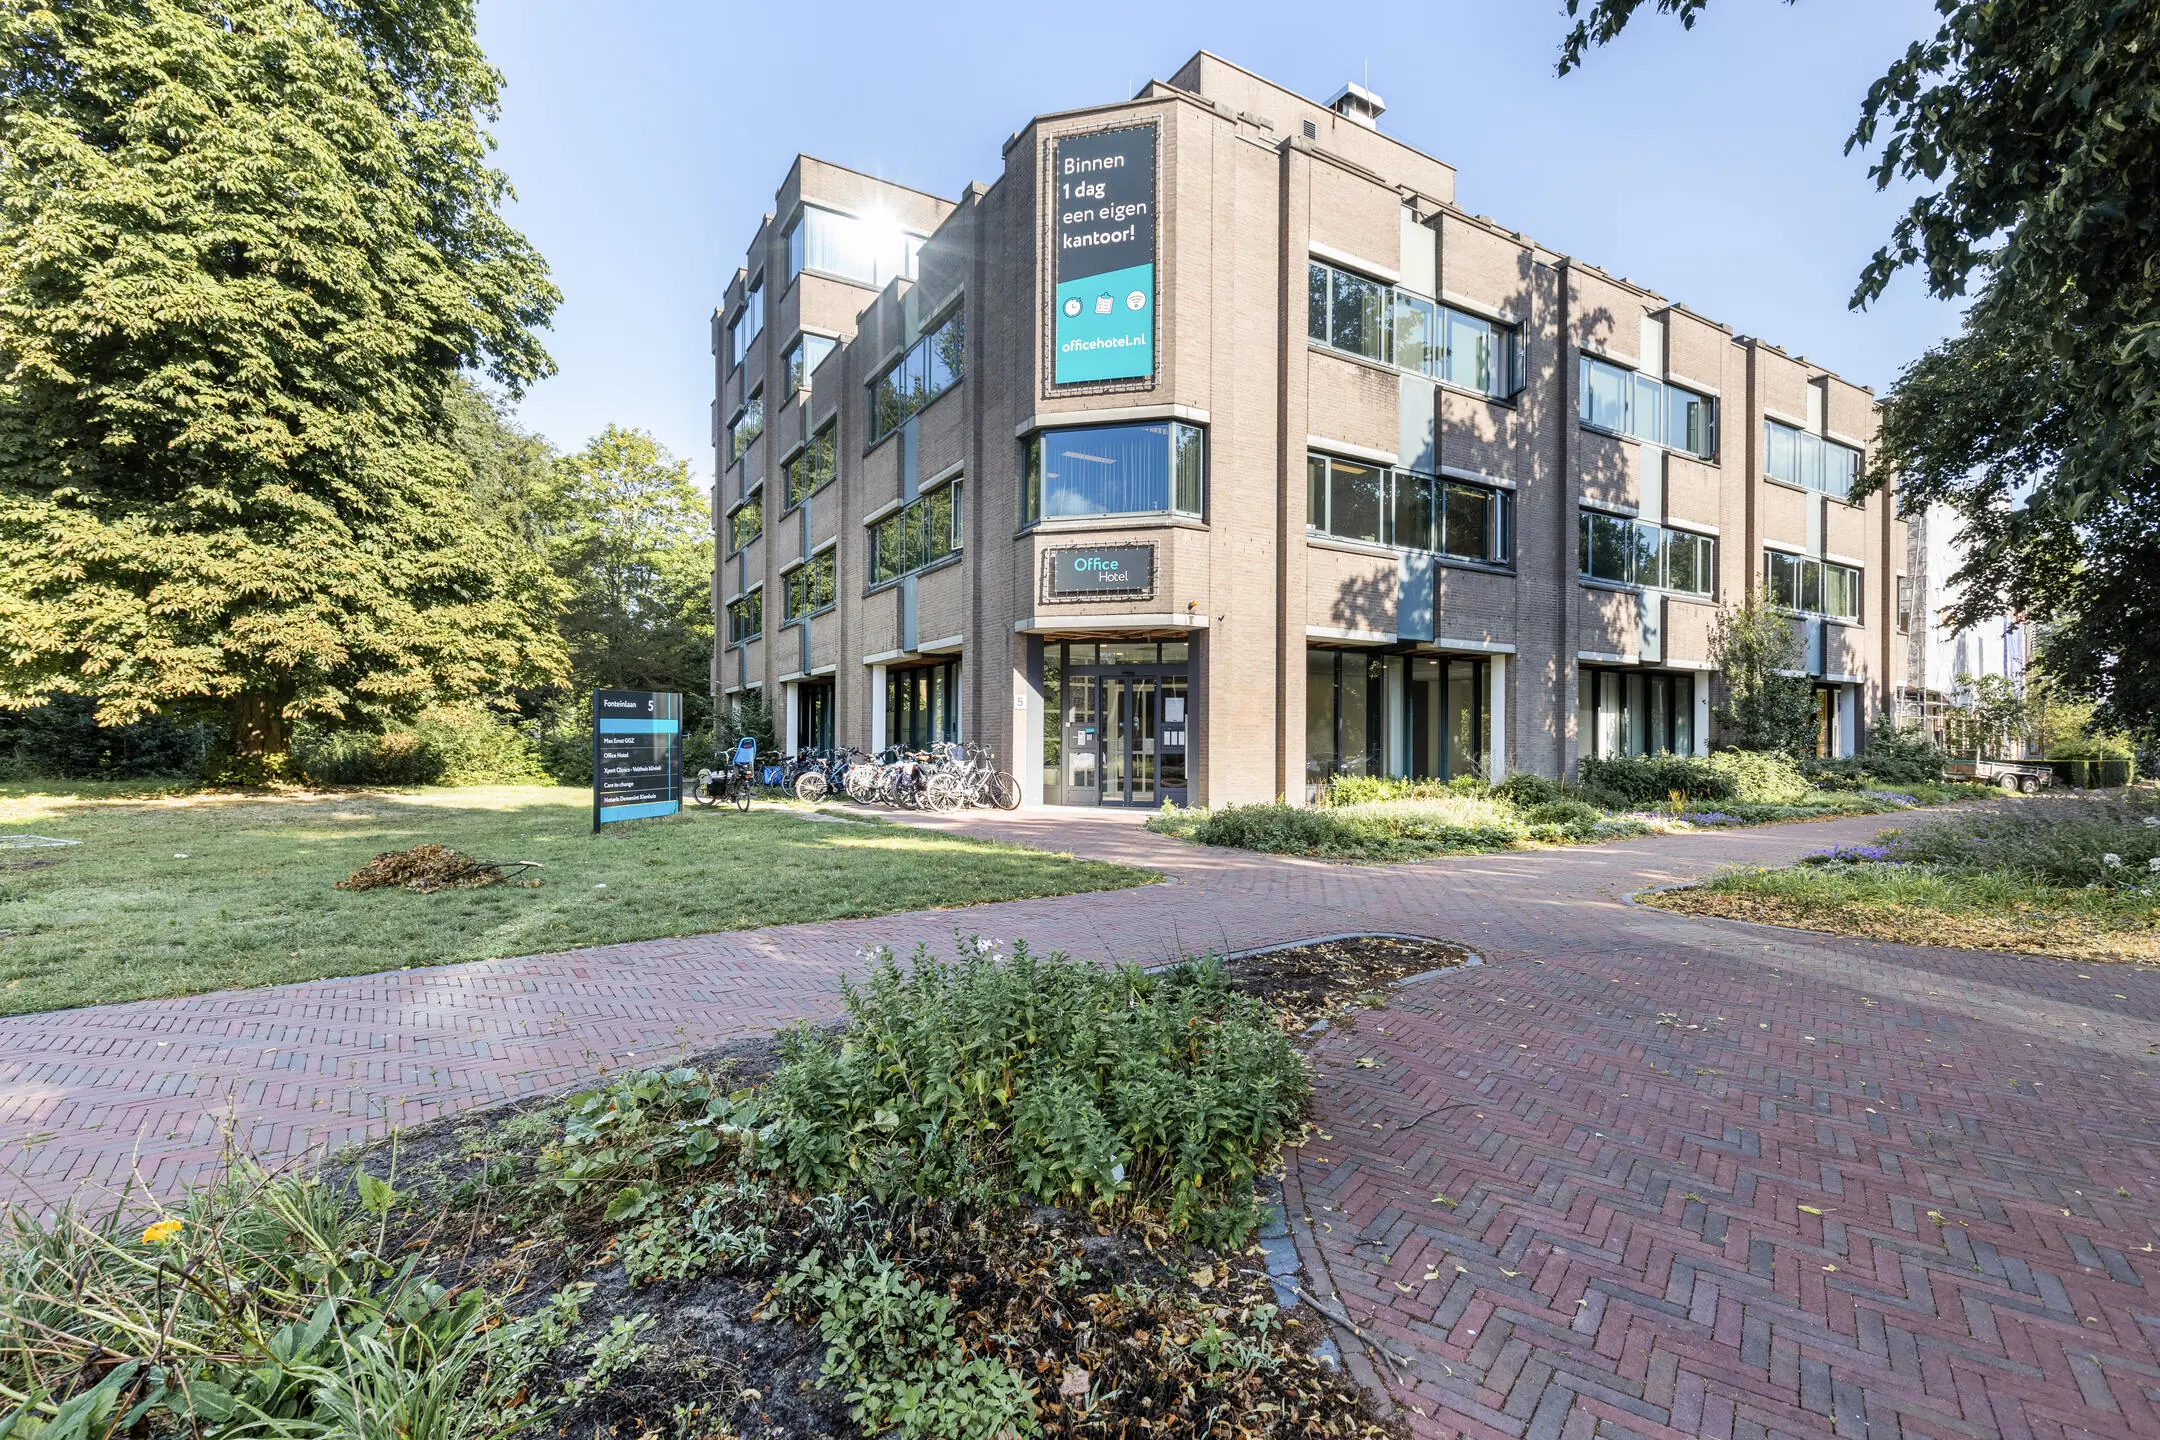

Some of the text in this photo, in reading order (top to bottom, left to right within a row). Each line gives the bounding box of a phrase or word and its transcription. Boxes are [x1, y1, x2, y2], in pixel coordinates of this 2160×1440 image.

[1064, 155, 1125, 175] Binnen
[1063, 181, 1106, 199] 1 dag
[1062, 202, 1147, 224] een eigen
[1063, 224, 1135, 249] kantoor!
[1062, 332, 1147, 353] officehotel.nl
[1074, 557, 1119, 572] Office
[1099, 570, 1129, 582] Hotel
[603, 699, 654, 712] Fonteinlaan 5
[1017, 696, 1024, 707] 5
